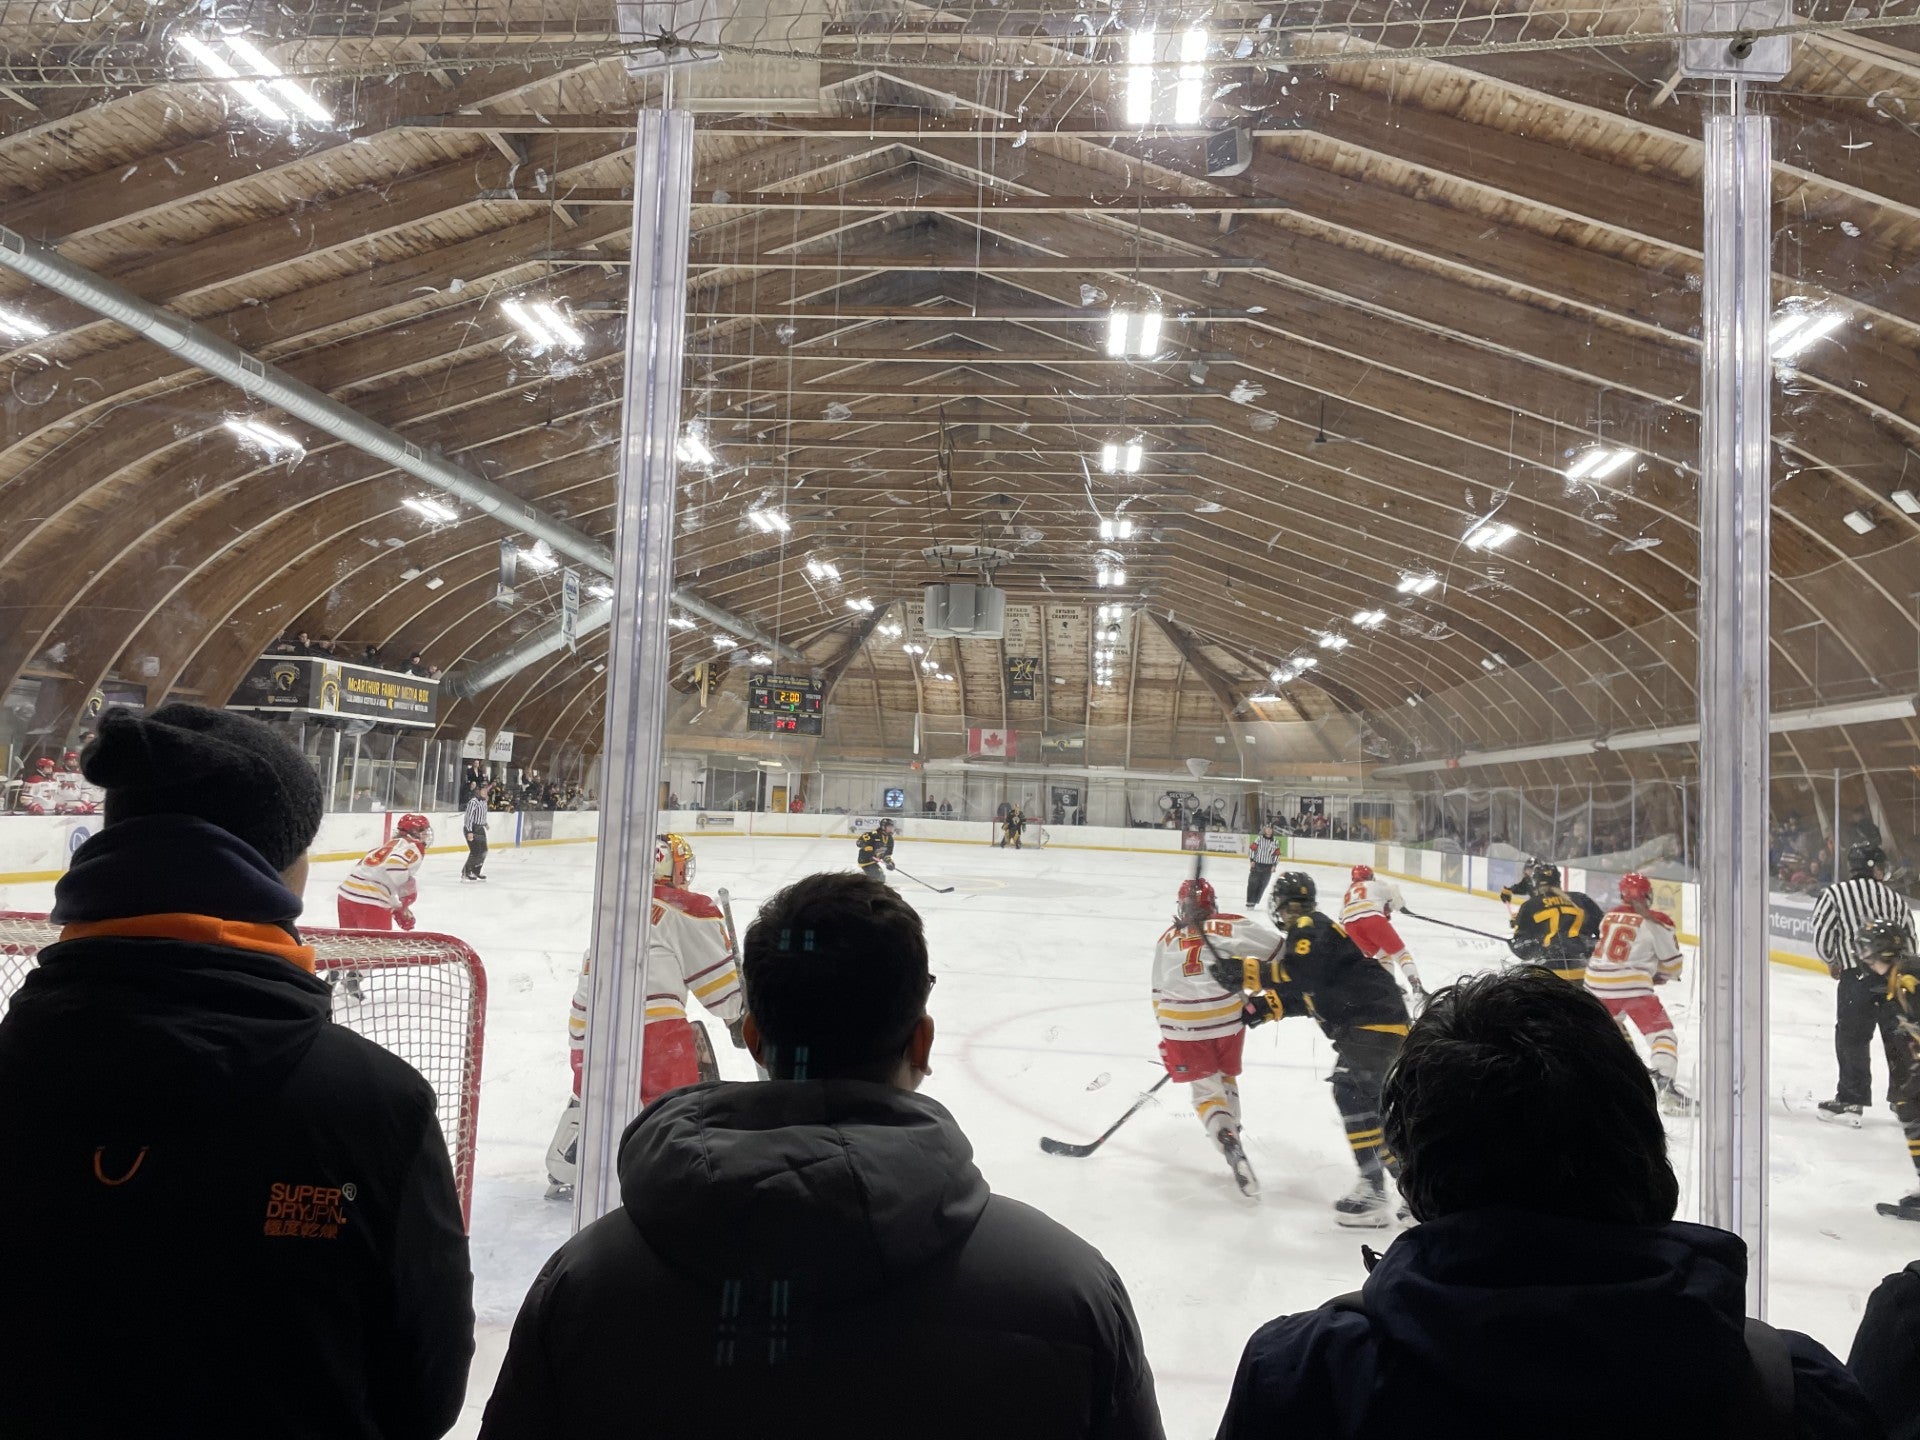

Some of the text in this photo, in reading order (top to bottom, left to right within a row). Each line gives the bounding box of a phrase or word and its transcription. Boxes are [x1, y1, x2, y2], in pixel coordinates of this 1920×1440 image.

[347, 677, 380, 696] McARTHUR
[381, 682, 401, 698] FAMILY
[780, 691, 800, 703] 2:00
[1062, 794, 1070, 804] 6
[1533, 906, 1585, 948] 77
[1769, 912, 1815, 936] nterpris
[1295, 938, 1312, 955] 8
[1593, 920, 1638, 963] 16
[1179, 936, 1206, 977] 7
[270, 1182, 341, 1206] SUPER
